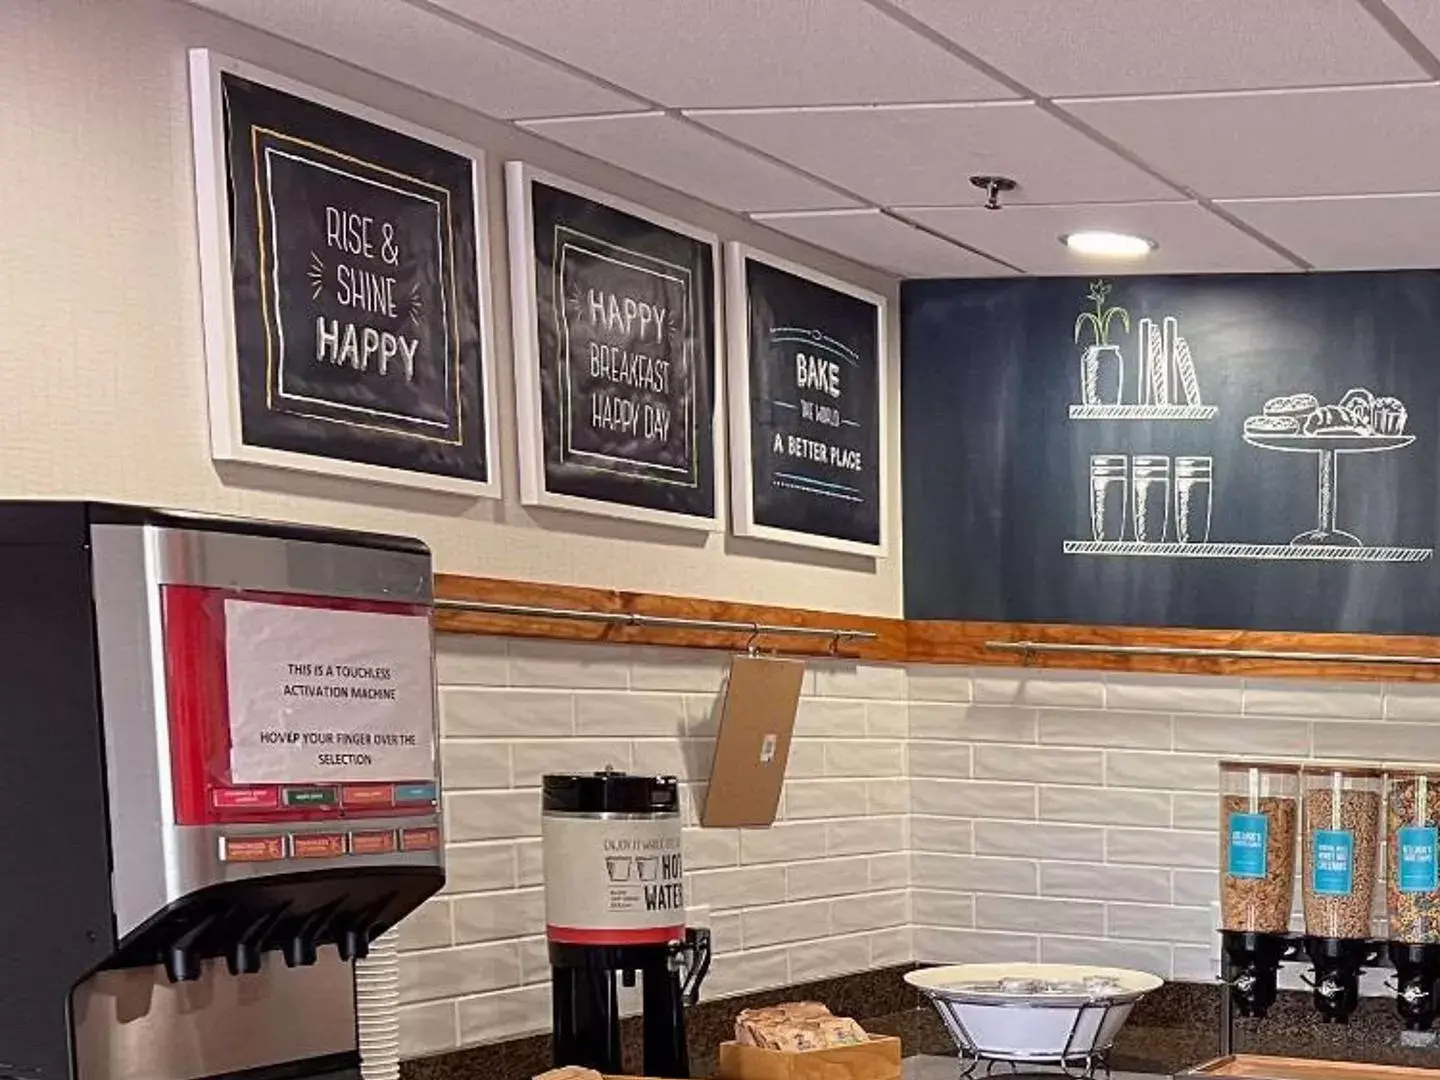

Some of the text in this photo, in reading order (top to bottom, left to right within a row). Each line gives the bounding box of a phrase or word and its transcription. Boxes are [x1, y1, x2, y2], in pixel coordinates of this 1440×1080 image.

[326, 206, 399, 266] RISE &
[336, 265, 398, 318] SHINE
[588, 288, 666, 344] HAPPY
[316, 316, 418, 381] HAPPY
[590, 341, 670, 395] BREAKFAST
[796, 352, 840, 398] BAKE
[592, 392, 671, 442] HAPPY DAY
[773, 433, 862, 471] A BETTER PLACE
[283, 685, 396, 700] ACTIVATION MACHINE
[288, 664, 392, 680] THIS IS A TOUCHLESS
[303, 733, 333, 745] YOUR
[337, 733, 372, 745] FINGER
[374, 734, 399, 745] OVER
[400, 734, 416, 746] THE
[318, 754, 372, 765] SELECTION
